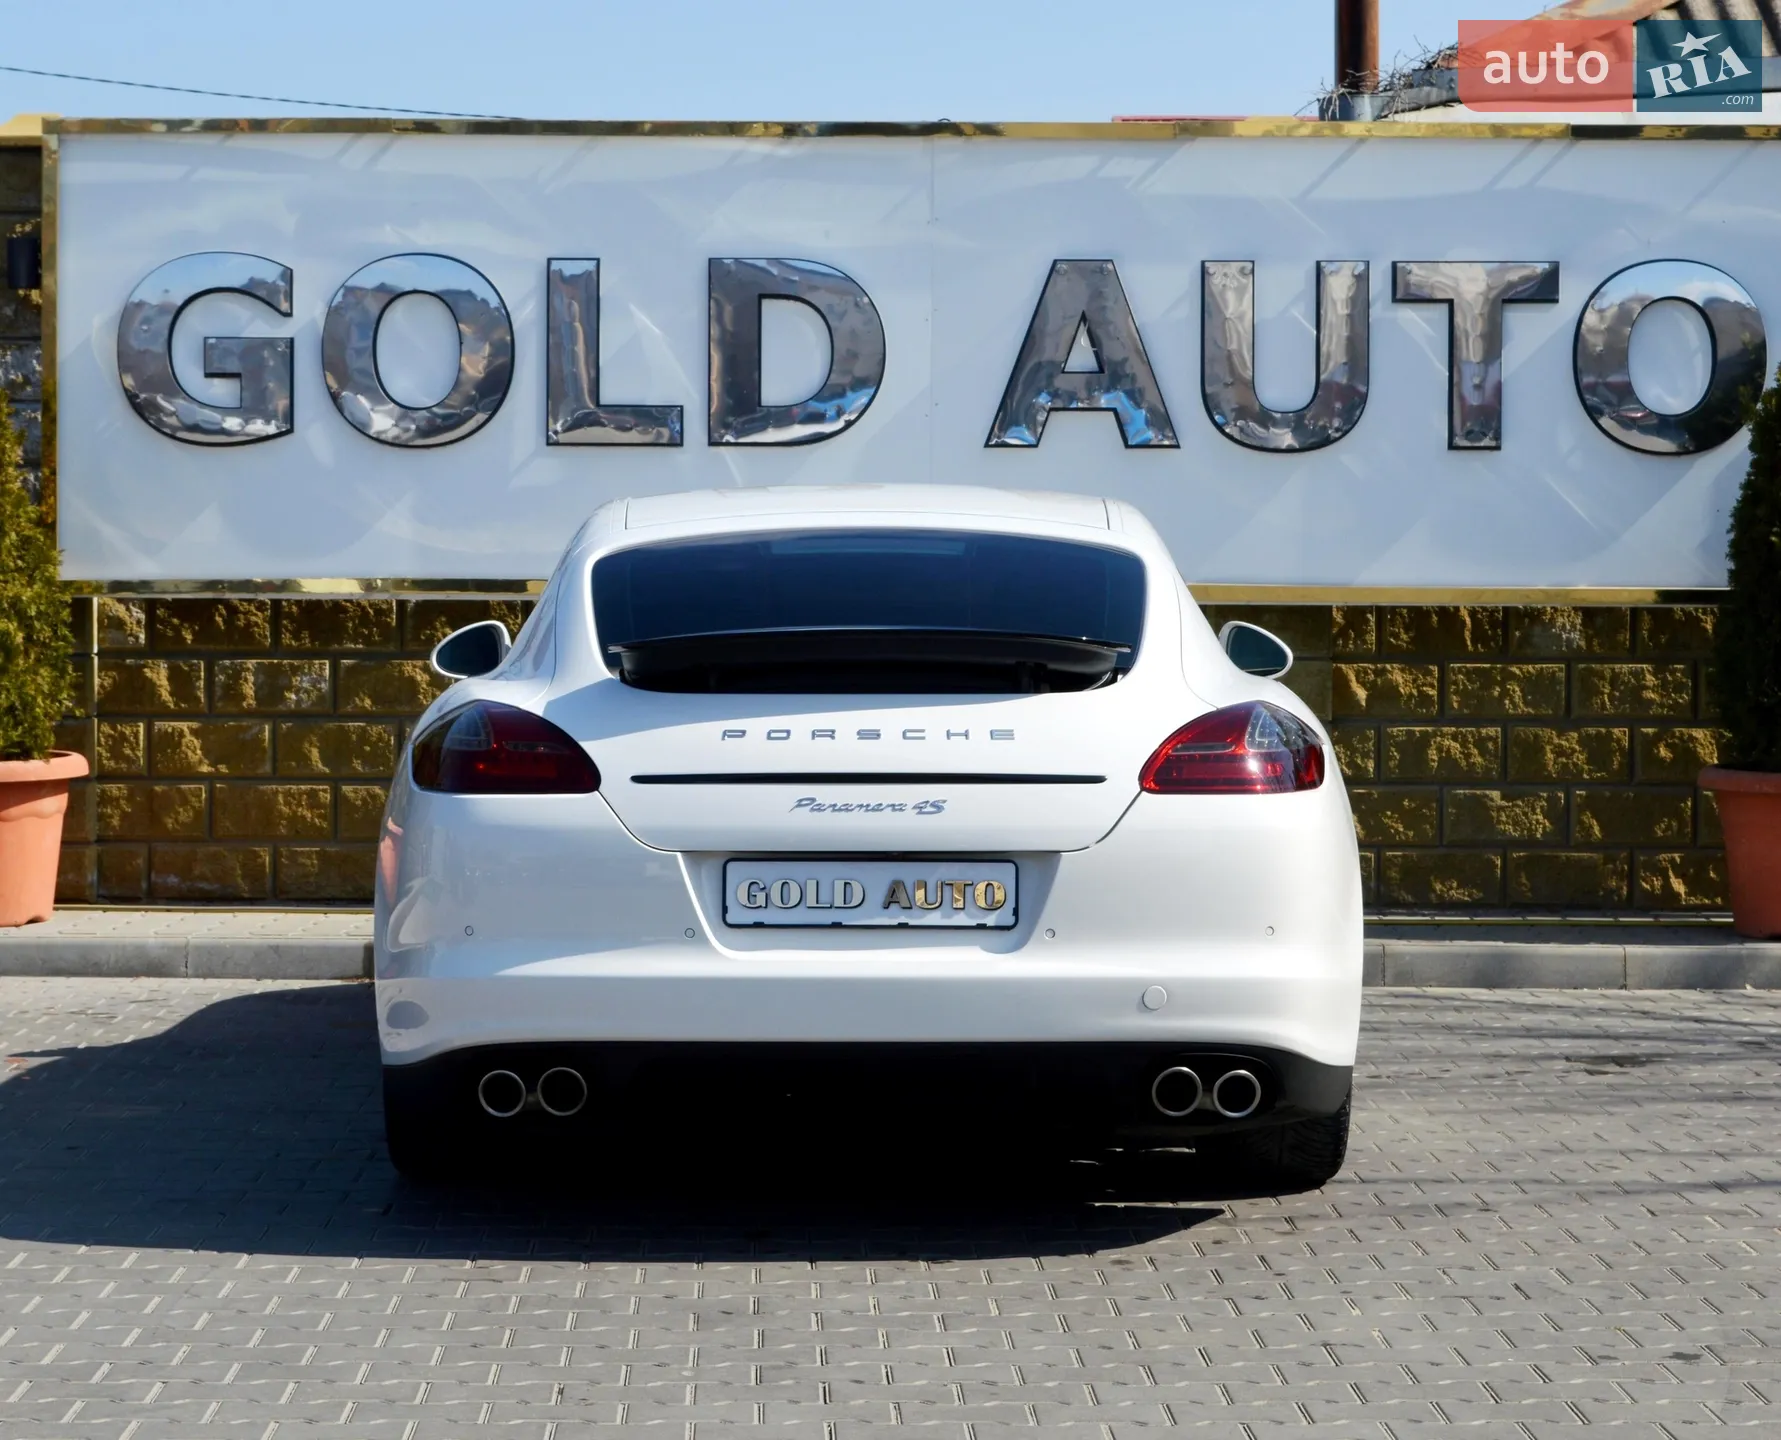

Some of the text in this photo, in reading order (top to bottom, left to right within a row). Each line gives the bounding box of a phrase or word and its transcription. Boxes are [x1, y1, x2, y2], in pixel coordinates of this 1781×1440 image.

[117, 251, 1767, 455] GOLD AUTO
[721, 728, 1016, 741] PORSCHE
[789, 796, 947, 815] Panamera 4S
[736, 878, 1007, 911] GOLD AUTO
